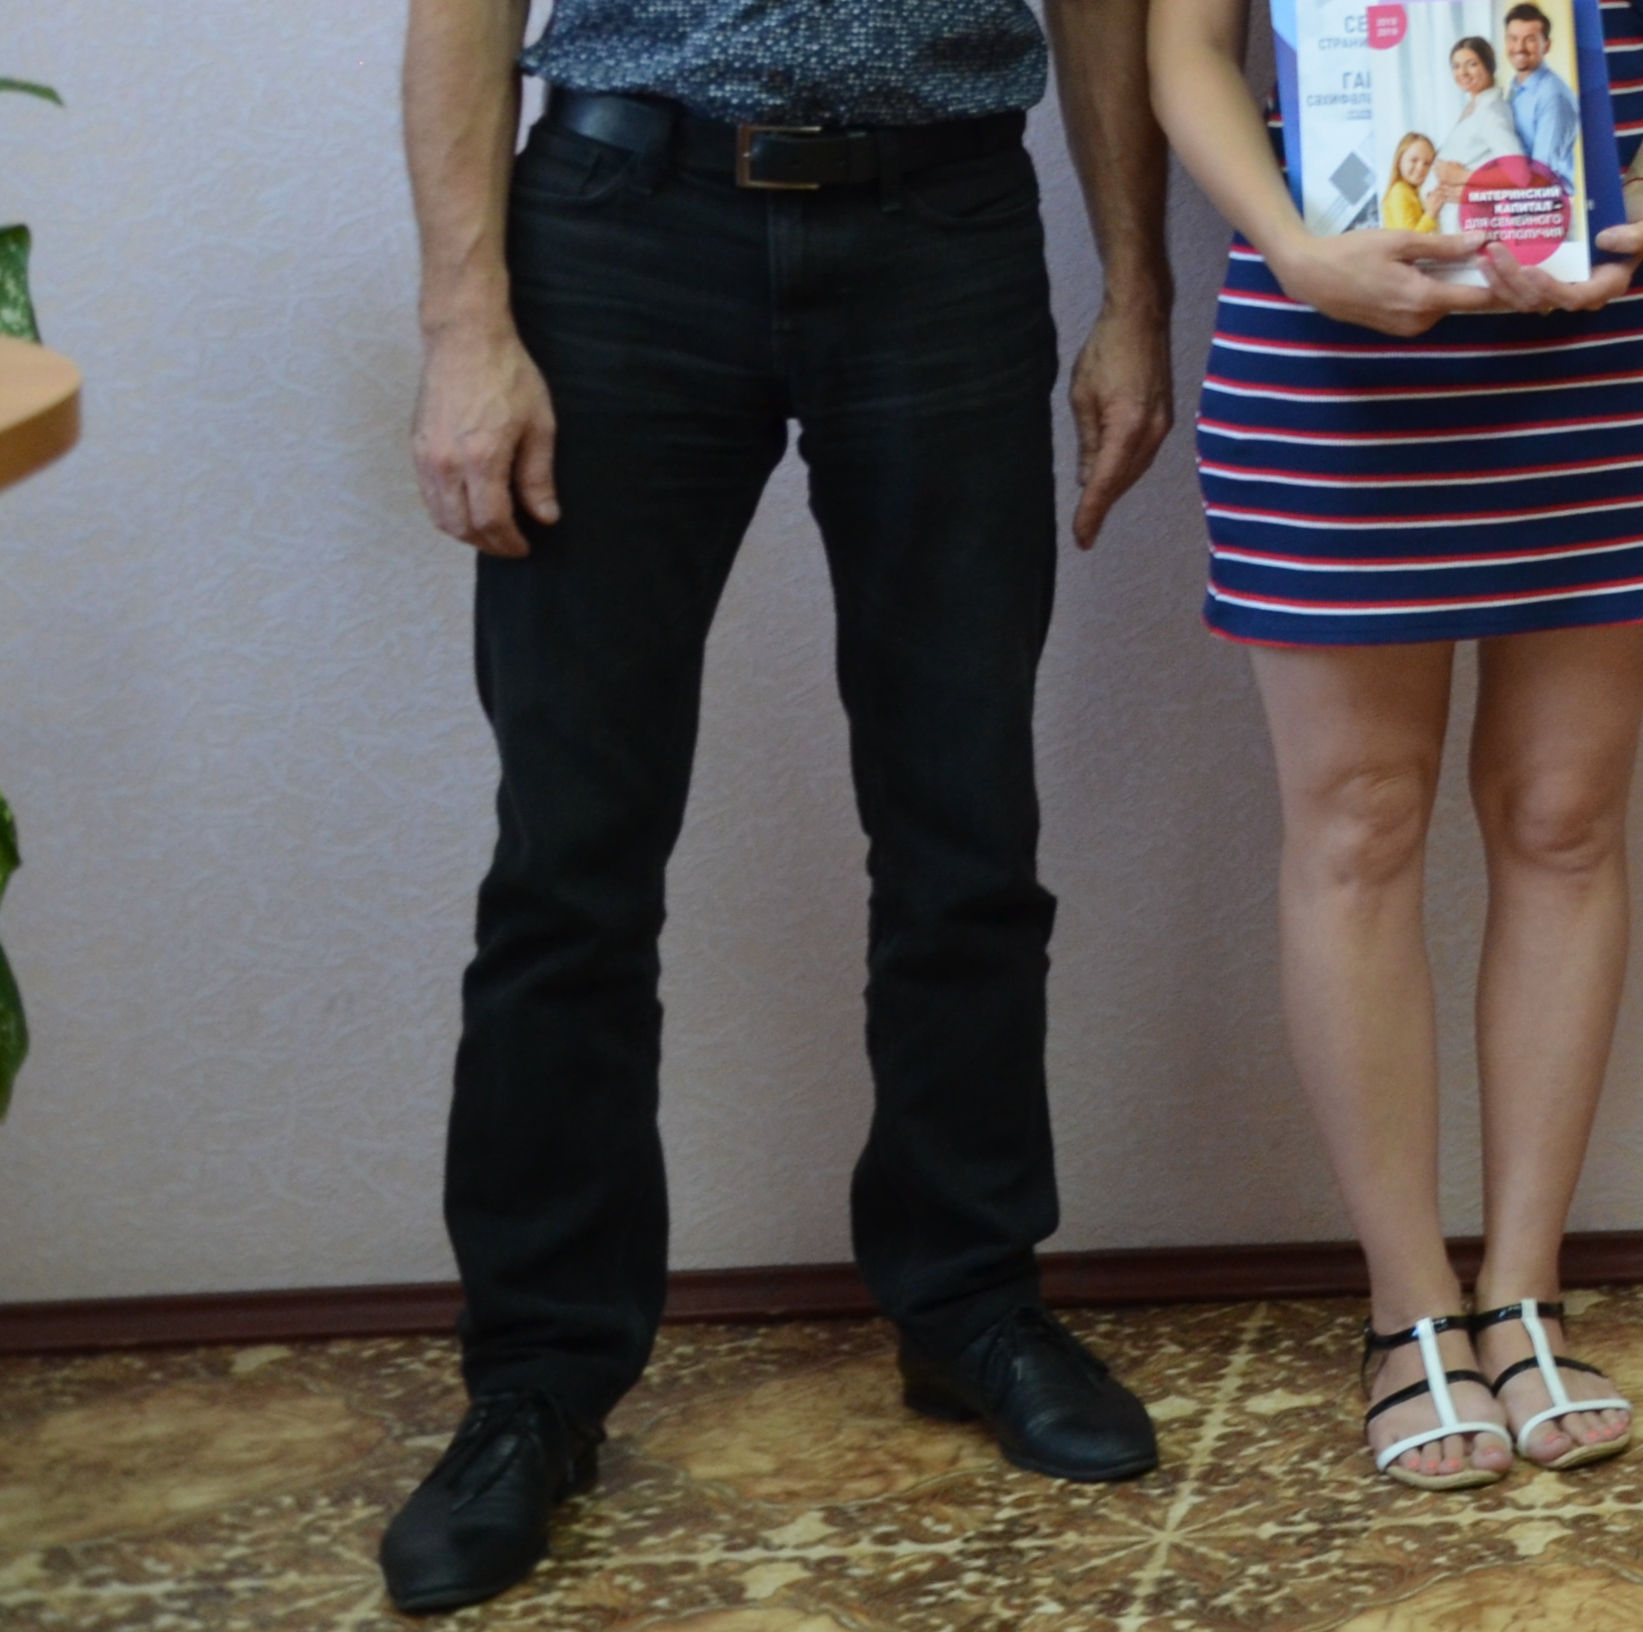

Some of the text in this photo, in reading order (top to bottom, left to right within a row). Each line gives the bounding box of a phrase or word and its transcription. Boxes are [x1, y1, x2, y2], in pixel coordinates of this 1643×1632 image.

[1468, 185, 1562, 202] МАТЕРИНСКИЙ
[1494, 200, 1552, 215] КАПИТАЛ
[1464, 213, 1563, 231] ДЛЯ СЕМЕЙНОГО
